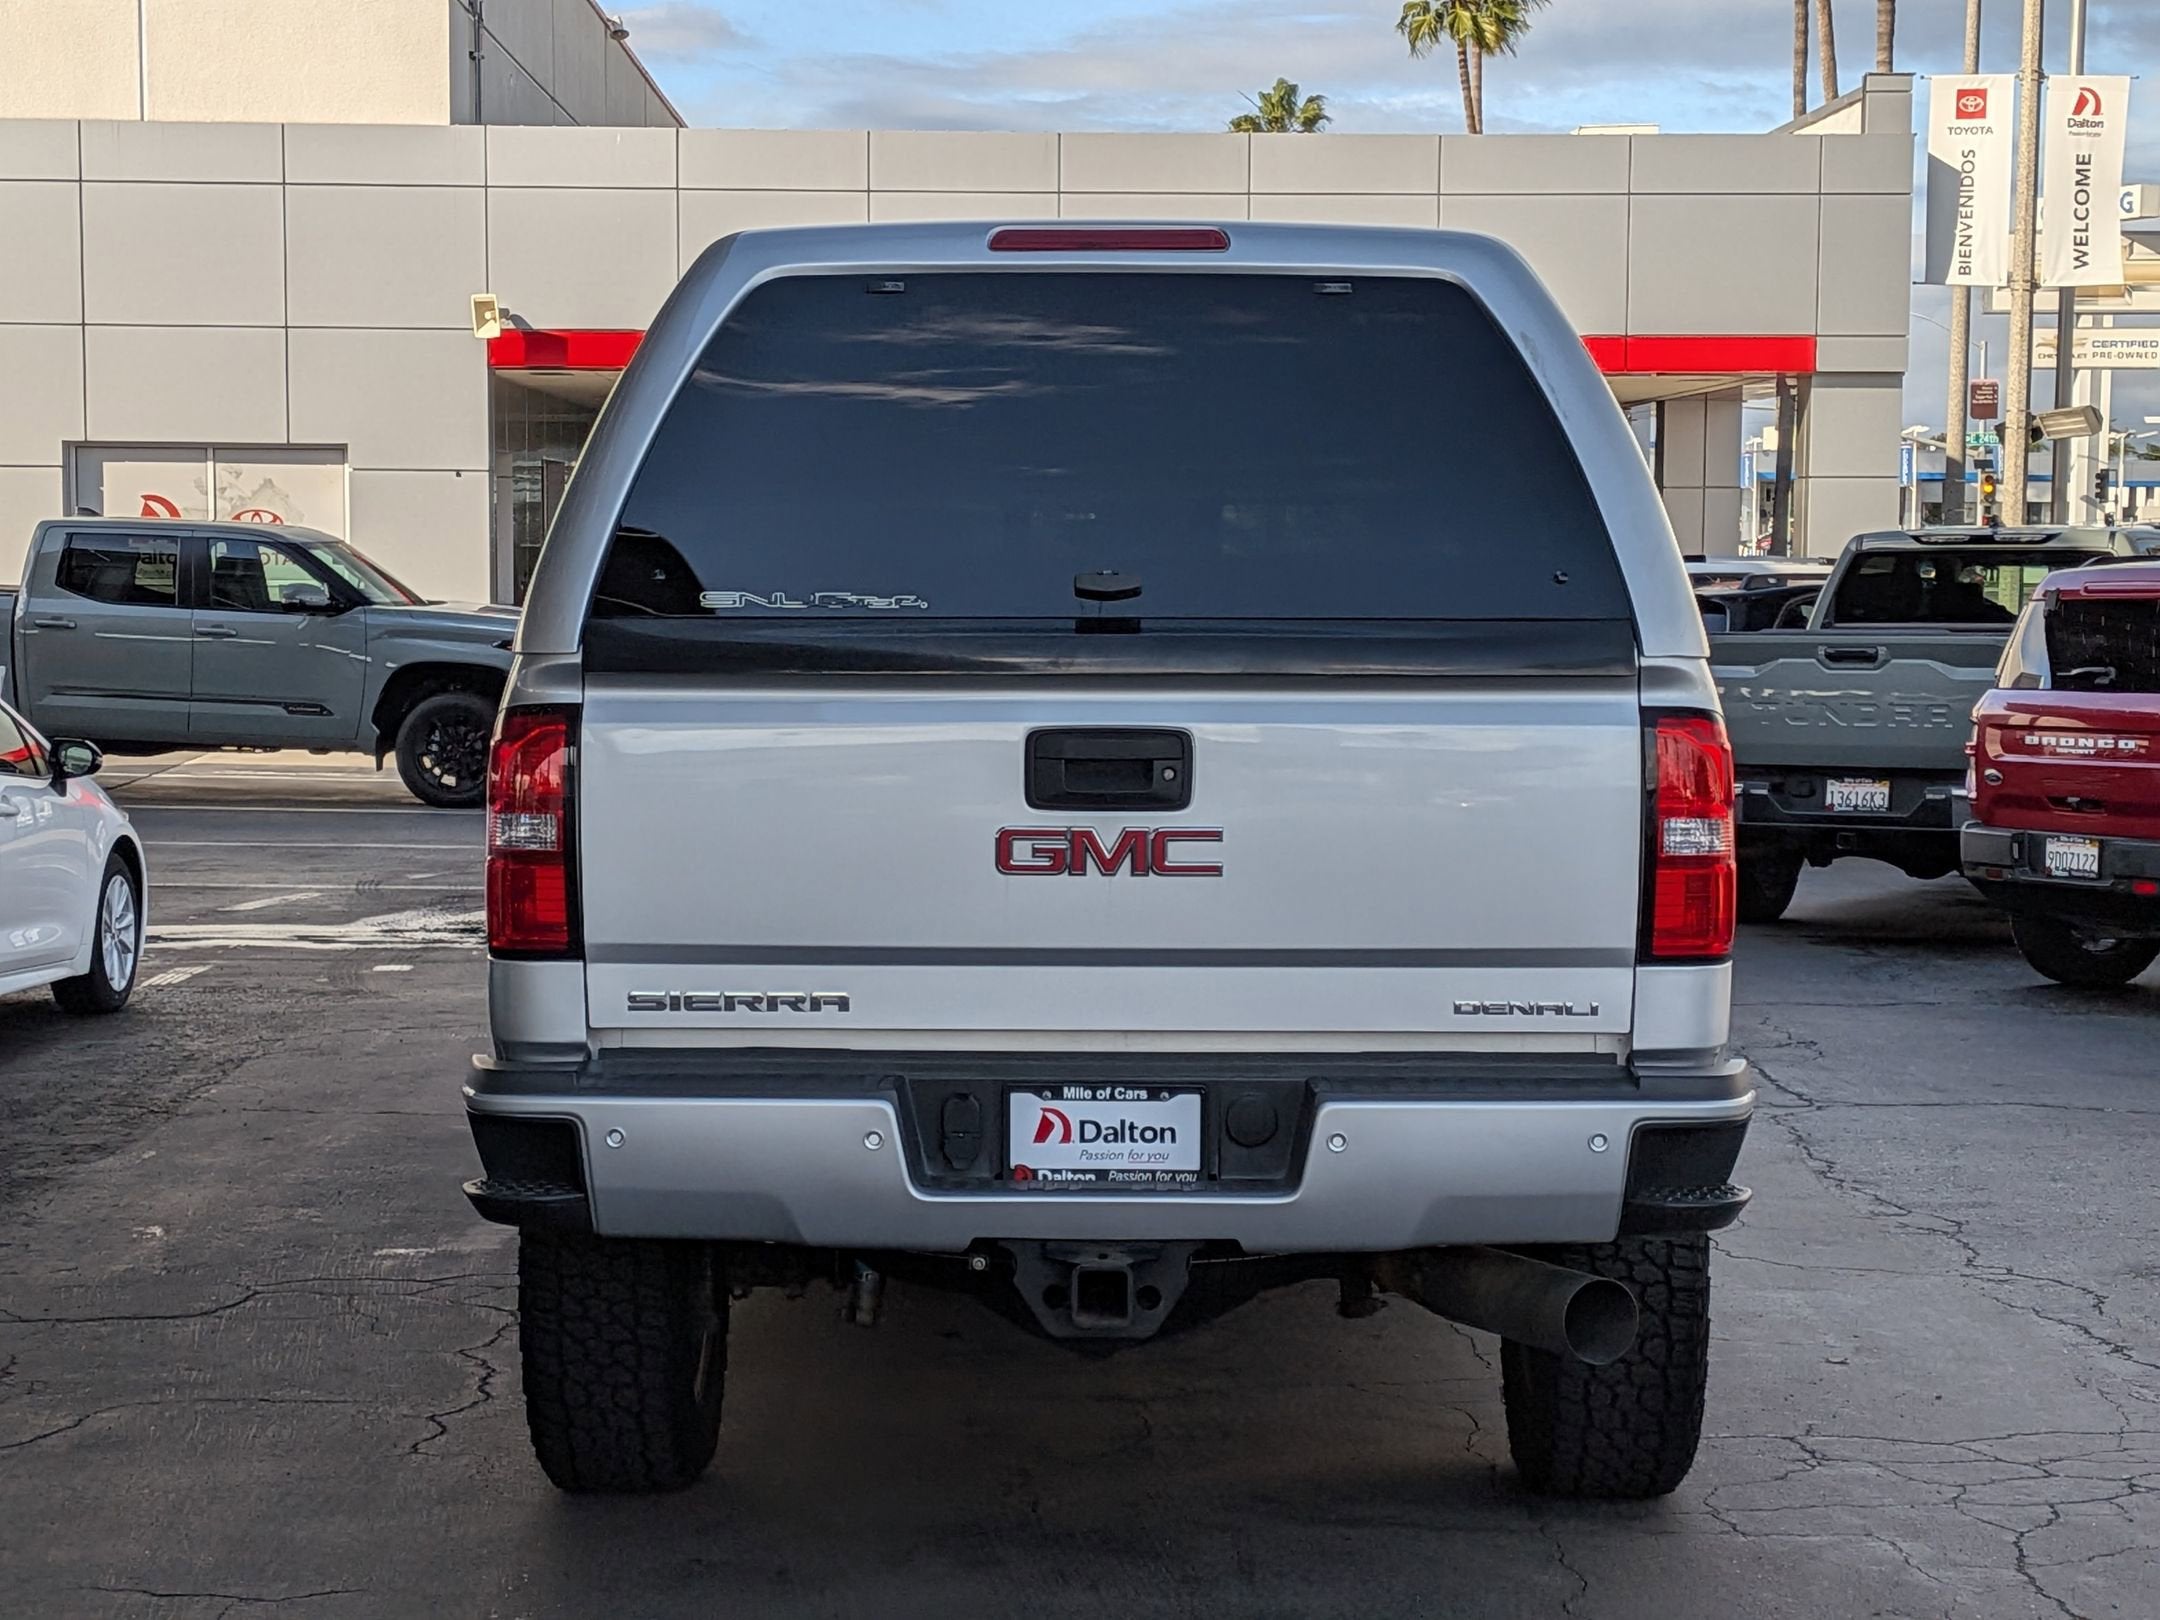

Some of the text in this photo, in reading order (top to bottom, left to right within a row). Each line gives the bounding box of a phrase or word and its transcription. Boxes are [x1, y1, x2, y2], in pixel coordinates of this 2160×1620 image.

[2067, 118, 2104, 128] Dalton
[1947, 126, 1994, 136] TOYOTA
[1958, 149, 1976, 276] BIENVENIDOS
[2073, 153, 2092, 270] WELCOME
[2092, 340, 2159, 348] CERTIFIED
[2092, 351, 2158, 360] PRE-OWNED
[1752, 701, 1954, 728] TUNDRA
[2024, 735, 2136, 749] BRONCO
[995, 826, 1224, 877] GMC
[627, 990, 850, 1013] SIERRA
[1453, 1000, 1600, 1017] DENALI
[1063, 1086, 1148, 1100] Mile of Cars
[1078, 1119, 1177, 1144] Dalton
[1079, 1149, 1169, 1163] Passion for you
[1037, 1169, 1197, 1182] Dalton Passion for you
